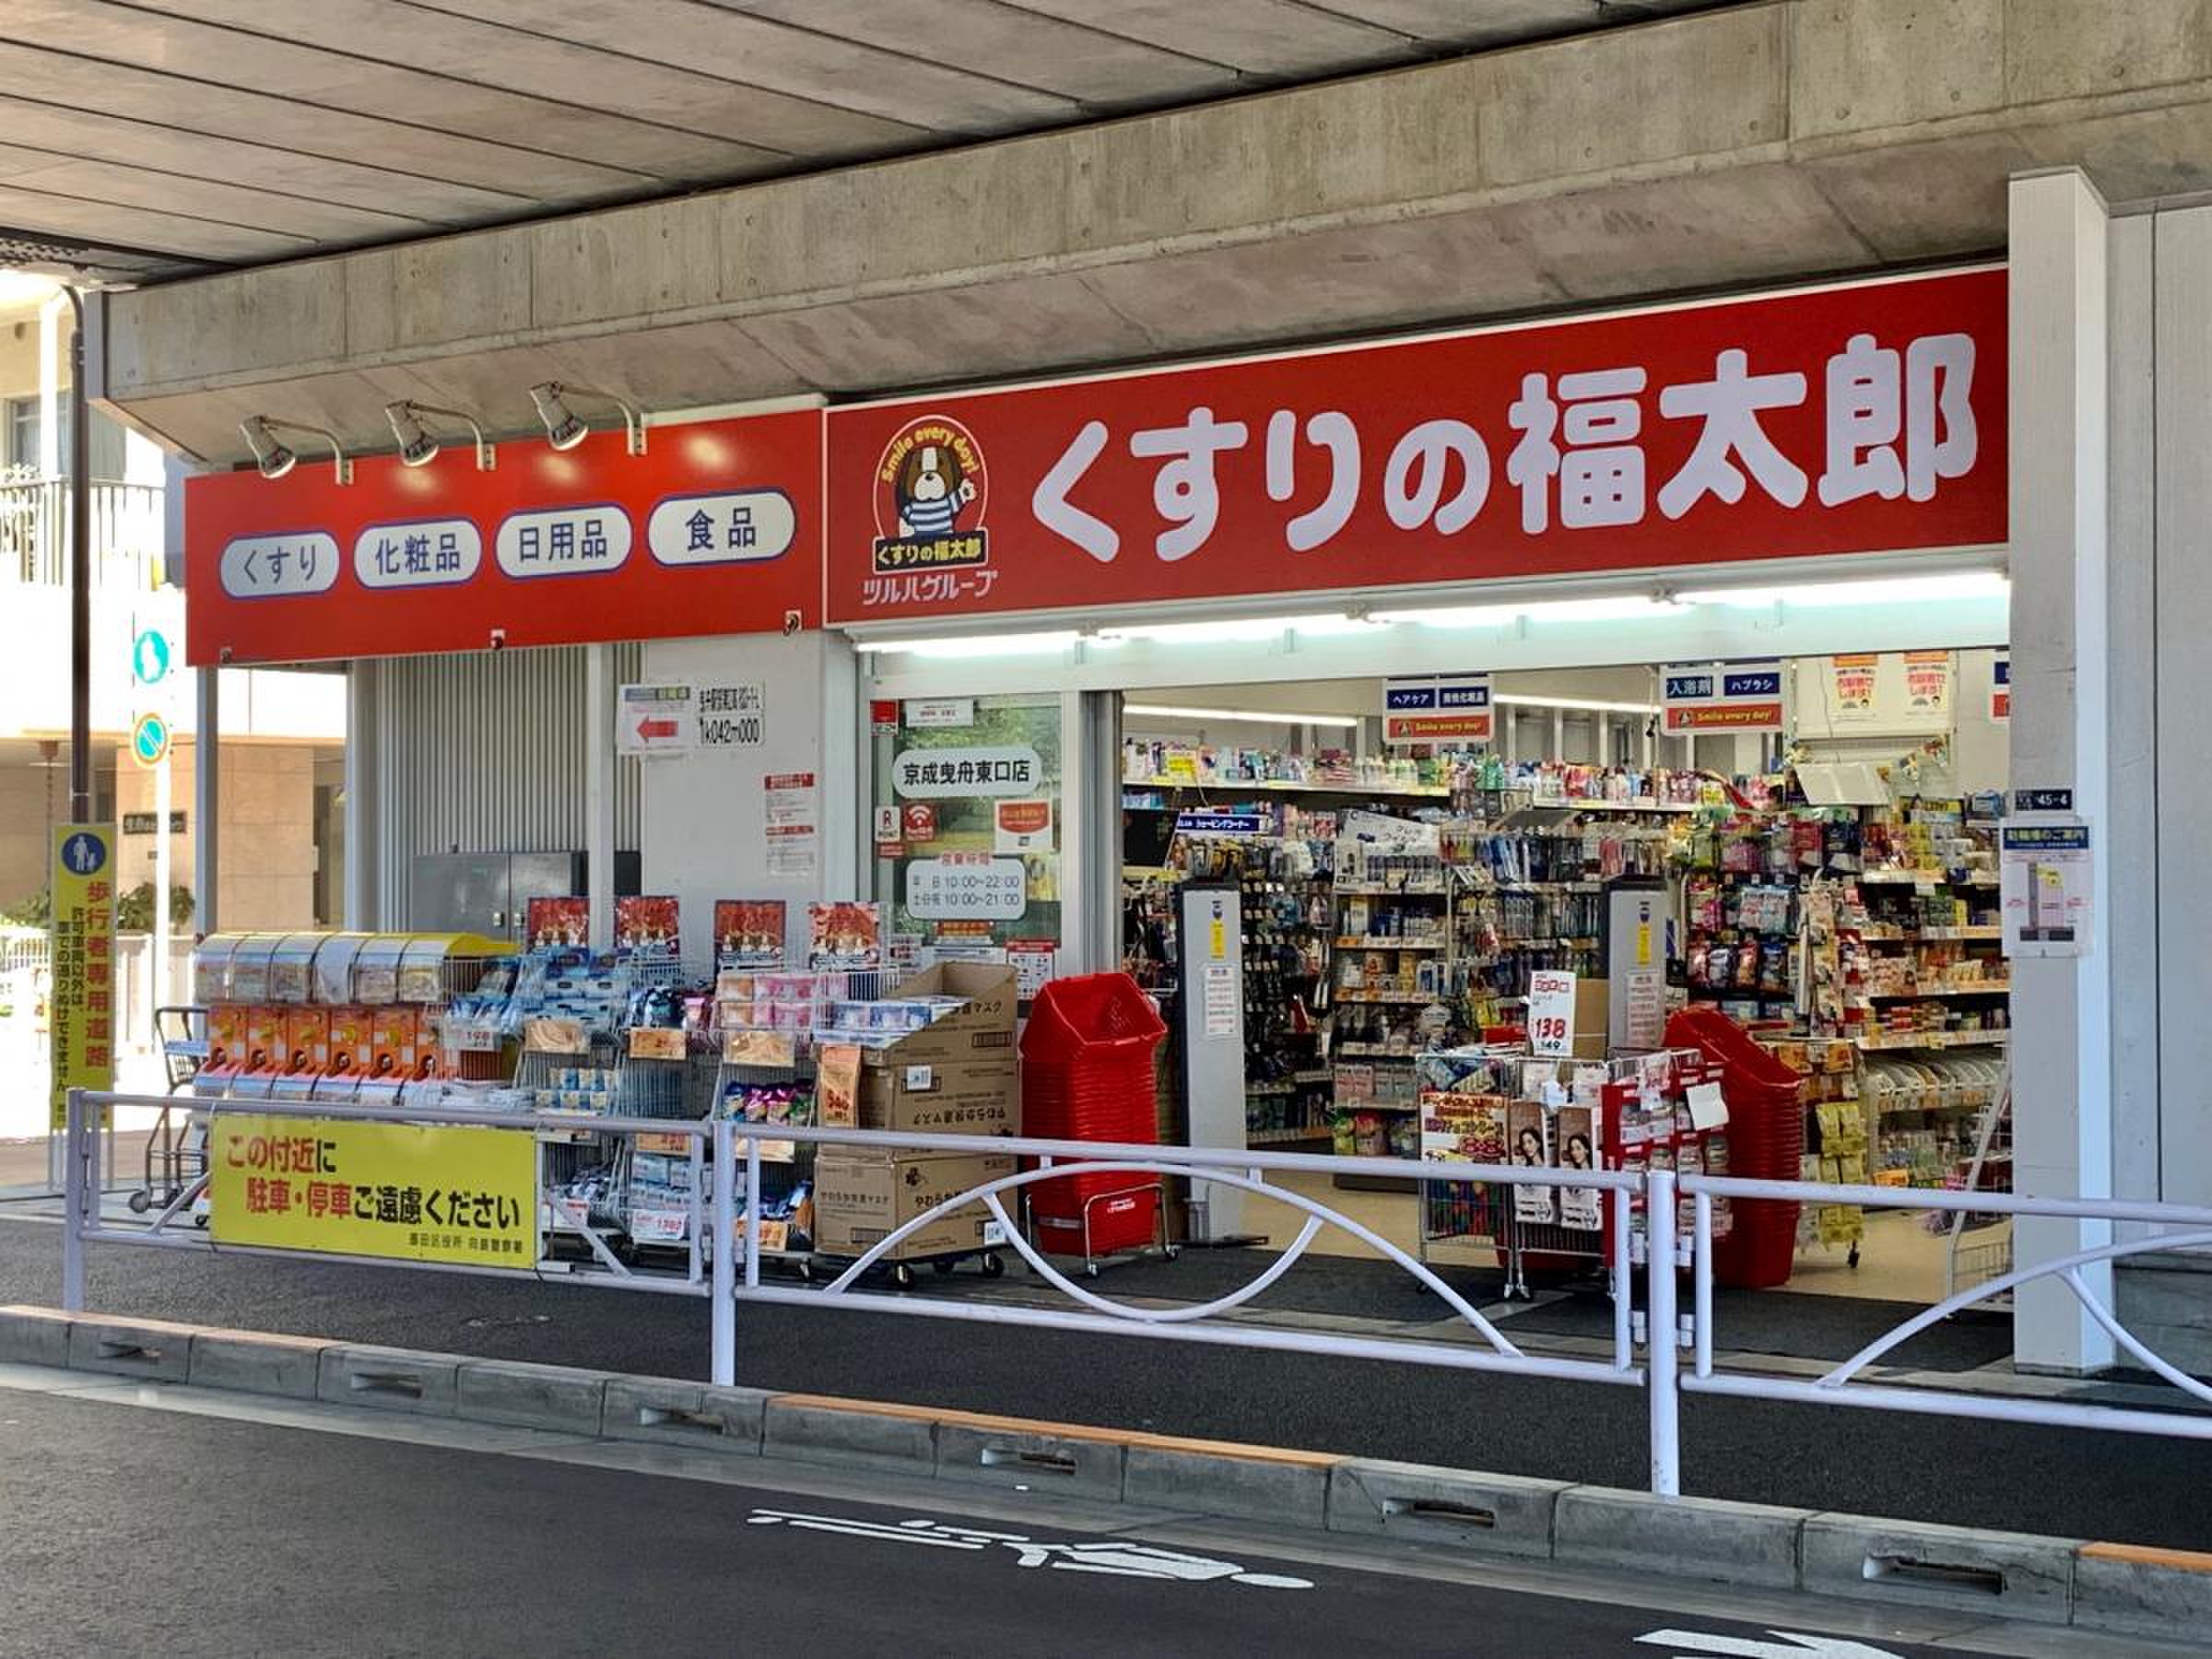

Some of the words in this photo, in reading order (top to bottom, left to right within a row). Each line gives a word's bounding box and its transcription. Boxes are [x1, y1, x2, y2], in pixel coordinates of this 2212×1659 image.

[881, 436, 914, 482] Smile
[914, 427, 955, 446] every
[1031, 334, 1978, 561] くすりの福太郎
[517, 518, 609, 563] 日用品
[685, 506, 758, 553] 食品
[242, 545, 319, 584] くすり
[374, 532, 462, 576] 化粧品
[877, 537, 982, 565] くすりの福太郎
[863, 570, 998, 606] ツルハグループ
[1393, 693, 1430, 705] ヘアケア
[1732, 679, 1772, 691] ハブラシ
[903, 759, 1031, 785] 京成曳舟東口店
[86, 880, 110, 1068] 歩行者専用道路
[1535, 1017, 1566, 1039] 138
[227, 1134, 337, 1174] この付近に
[246, 1177, 521, 1230] 駐車・停車ご遠慮ください
